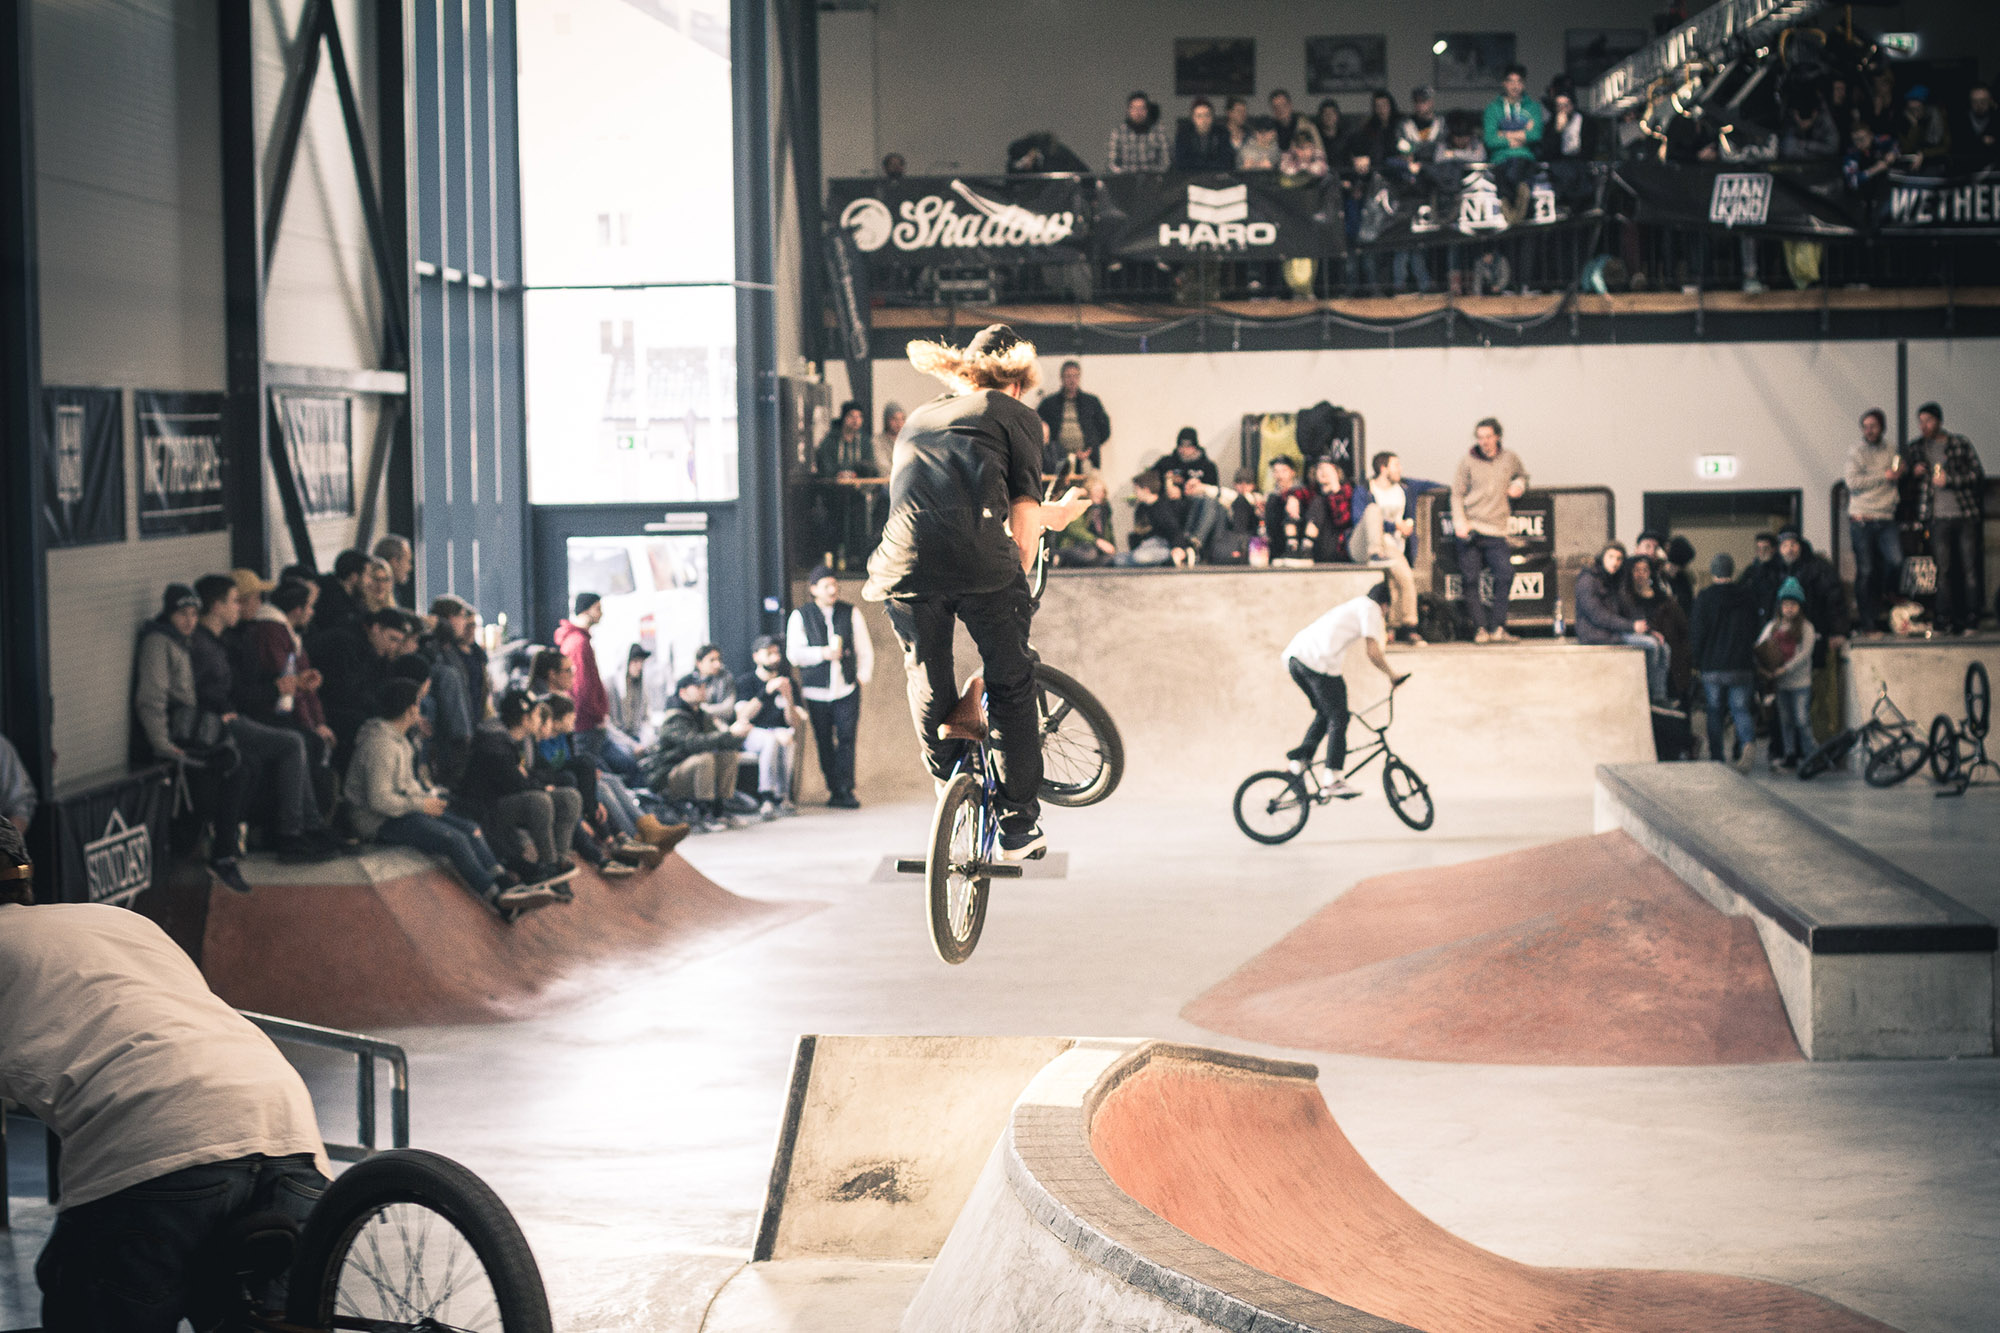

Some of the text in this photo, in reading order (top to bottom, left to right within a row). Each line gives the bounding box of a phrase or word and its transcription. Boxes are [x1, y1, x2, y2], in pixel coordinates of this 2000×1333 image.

[1720, 178, 1766, 198] MAN
[893, 181, 1073, 250] Shadow
[1159, 222, 1277, 246] HARO
